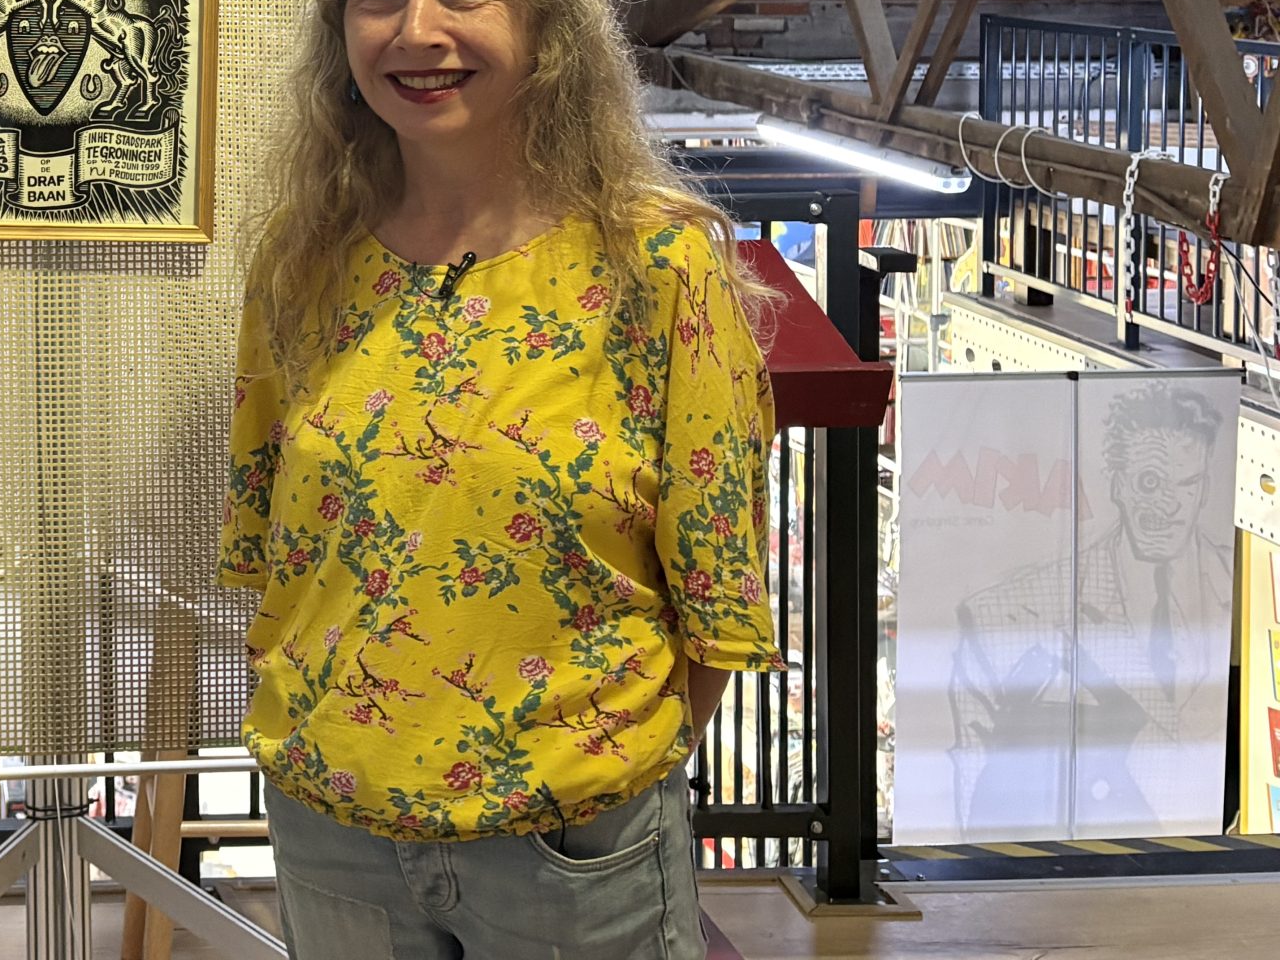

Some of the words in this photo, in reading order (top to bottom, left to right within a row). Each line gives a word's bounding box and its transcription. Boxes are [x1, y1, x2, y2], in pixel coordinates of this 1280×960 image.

[115, 133, 163, 149] STADSPARK
[114, 161, 121, 169] 2
[121, 162, 139, 171] JUNI
[141, 163, 161, 171] 1999
[27, 175, 66, 187] DRAF
[109, 169, 164, 181] PRODUCTIONS
[27, 190, 66, 202] BAAN
